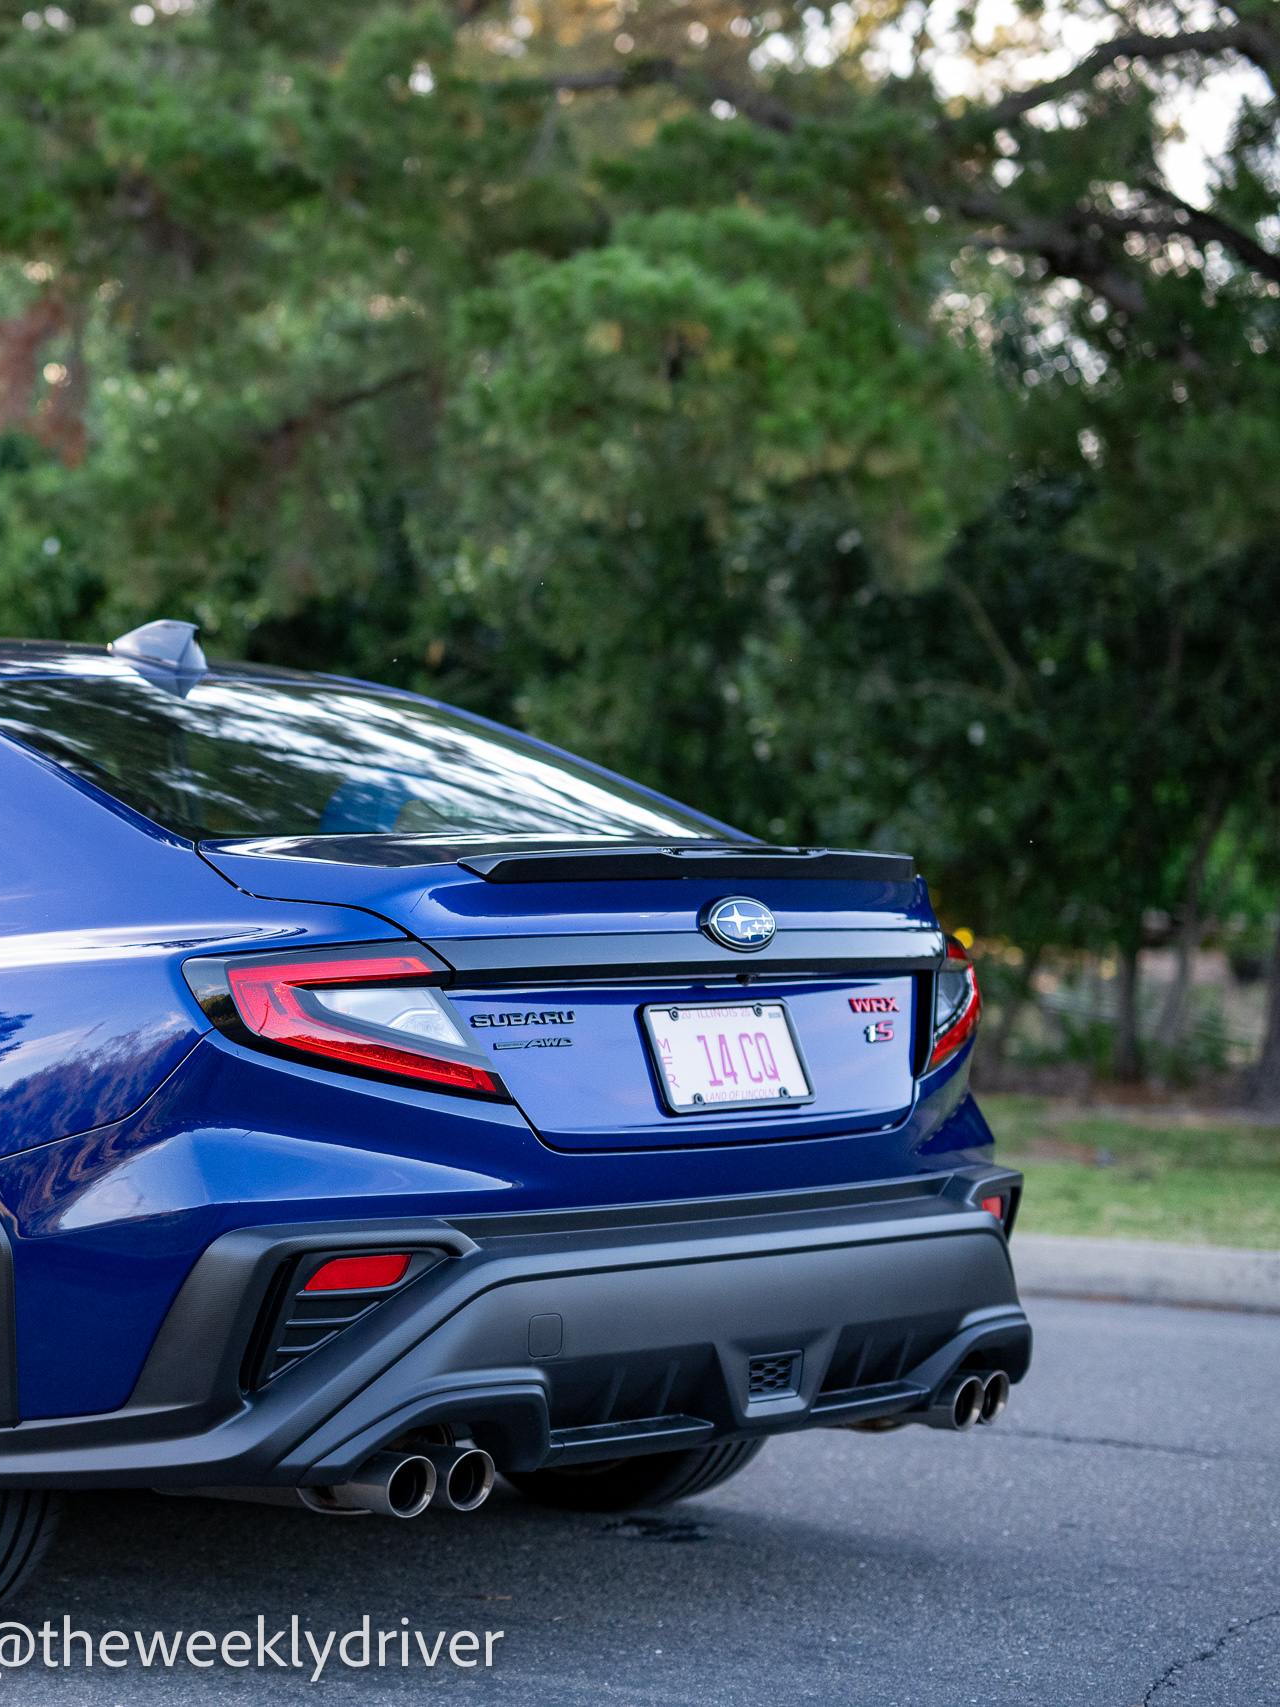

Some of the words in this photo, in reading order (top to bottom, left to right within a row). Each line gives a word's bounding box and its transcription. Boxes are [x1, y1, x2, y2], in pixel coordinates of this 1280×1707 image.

[848, 997, 900, 1013] WRX
[470, 1011, 576, 1028] SUBARU
[697, 1008, 738, 1019] ILLINOIS
[524, 1037, 575, 1049] AWD
[705, 1091, 727, 1102] LAND
[729, 1091, 740, 1100] OF
[741, 1088, 775, 1100] LINCOLN
